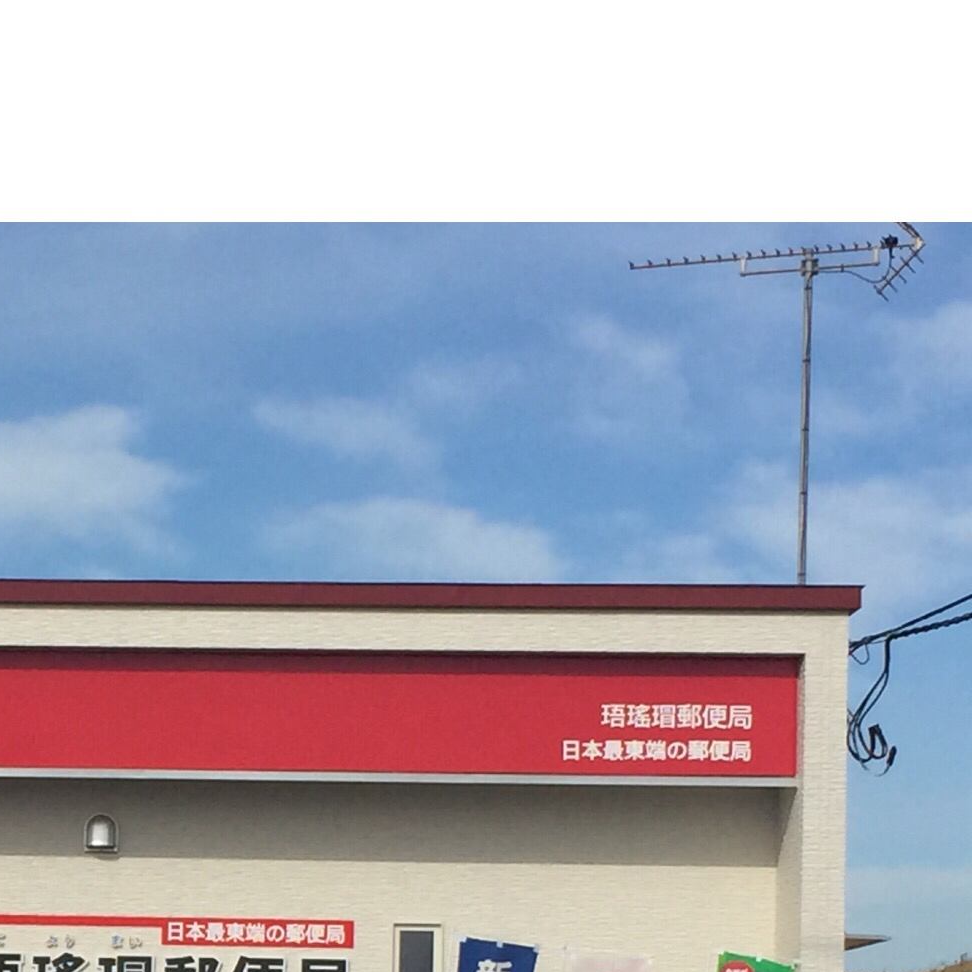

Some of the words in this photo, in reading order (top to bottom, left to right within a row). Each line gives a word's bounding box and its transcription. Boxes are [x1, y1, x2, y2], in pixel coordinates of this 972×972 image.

[562, 739, 752, 762] 日本最東端の郵便局
[167, 921, 346, 945] 日本最東端の郵便局
